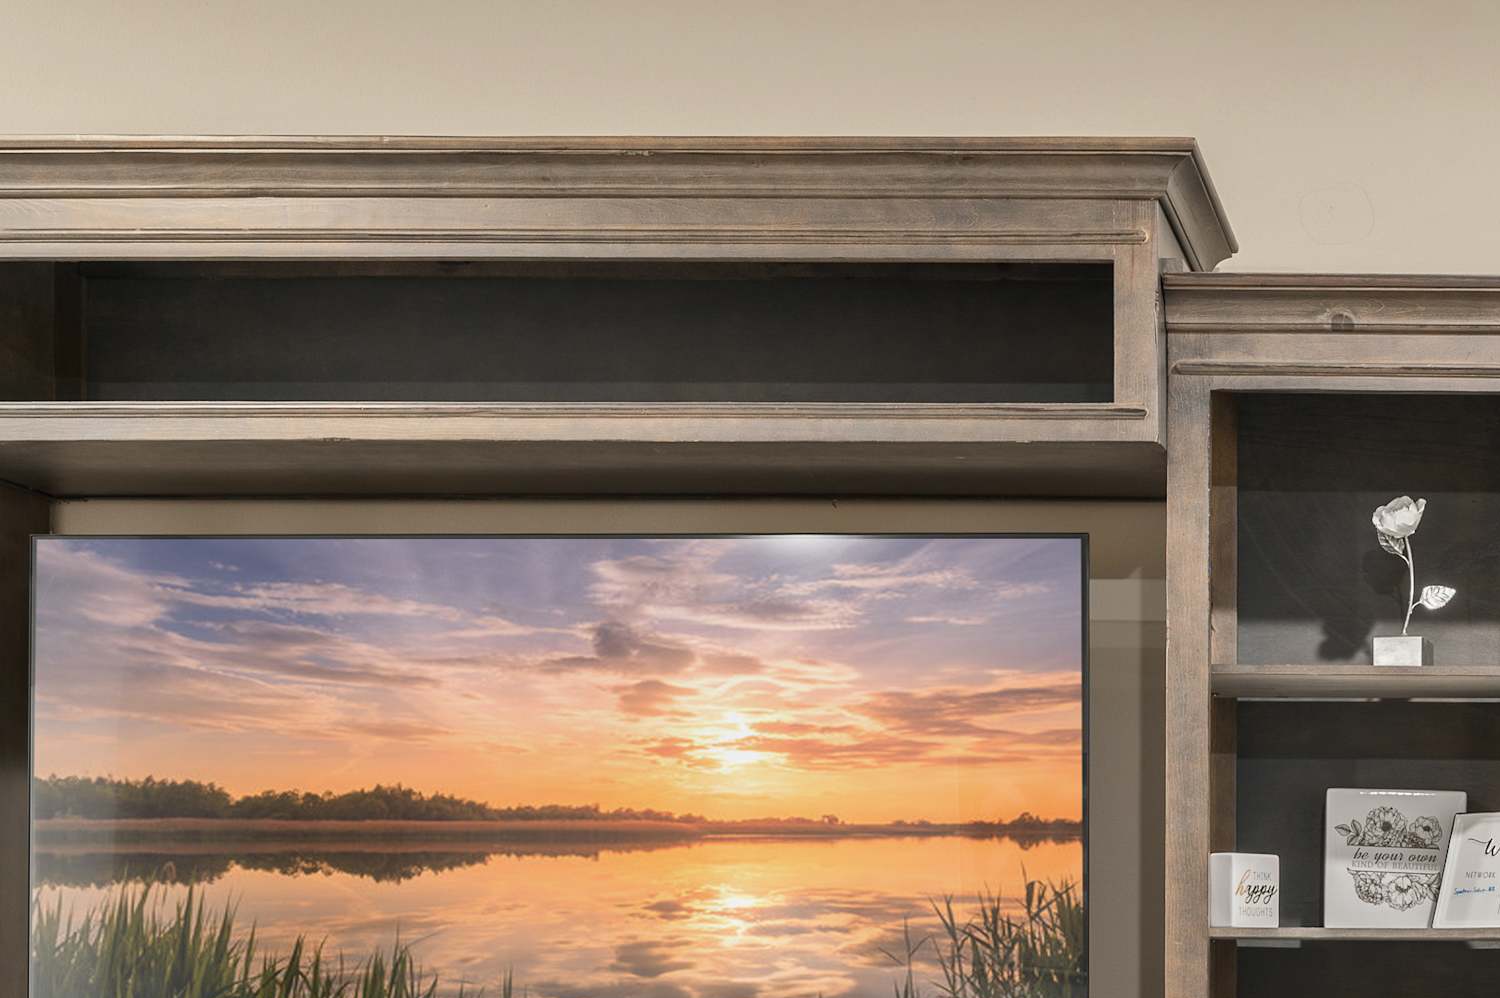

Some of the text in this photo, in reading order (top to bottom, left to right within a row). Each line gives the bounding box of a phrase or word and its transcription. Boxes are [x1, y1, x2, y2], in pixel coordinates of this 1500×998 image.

[1353, 847, 1437, 864] be your own
[1465, 871, 1496, 879] NETWORK
